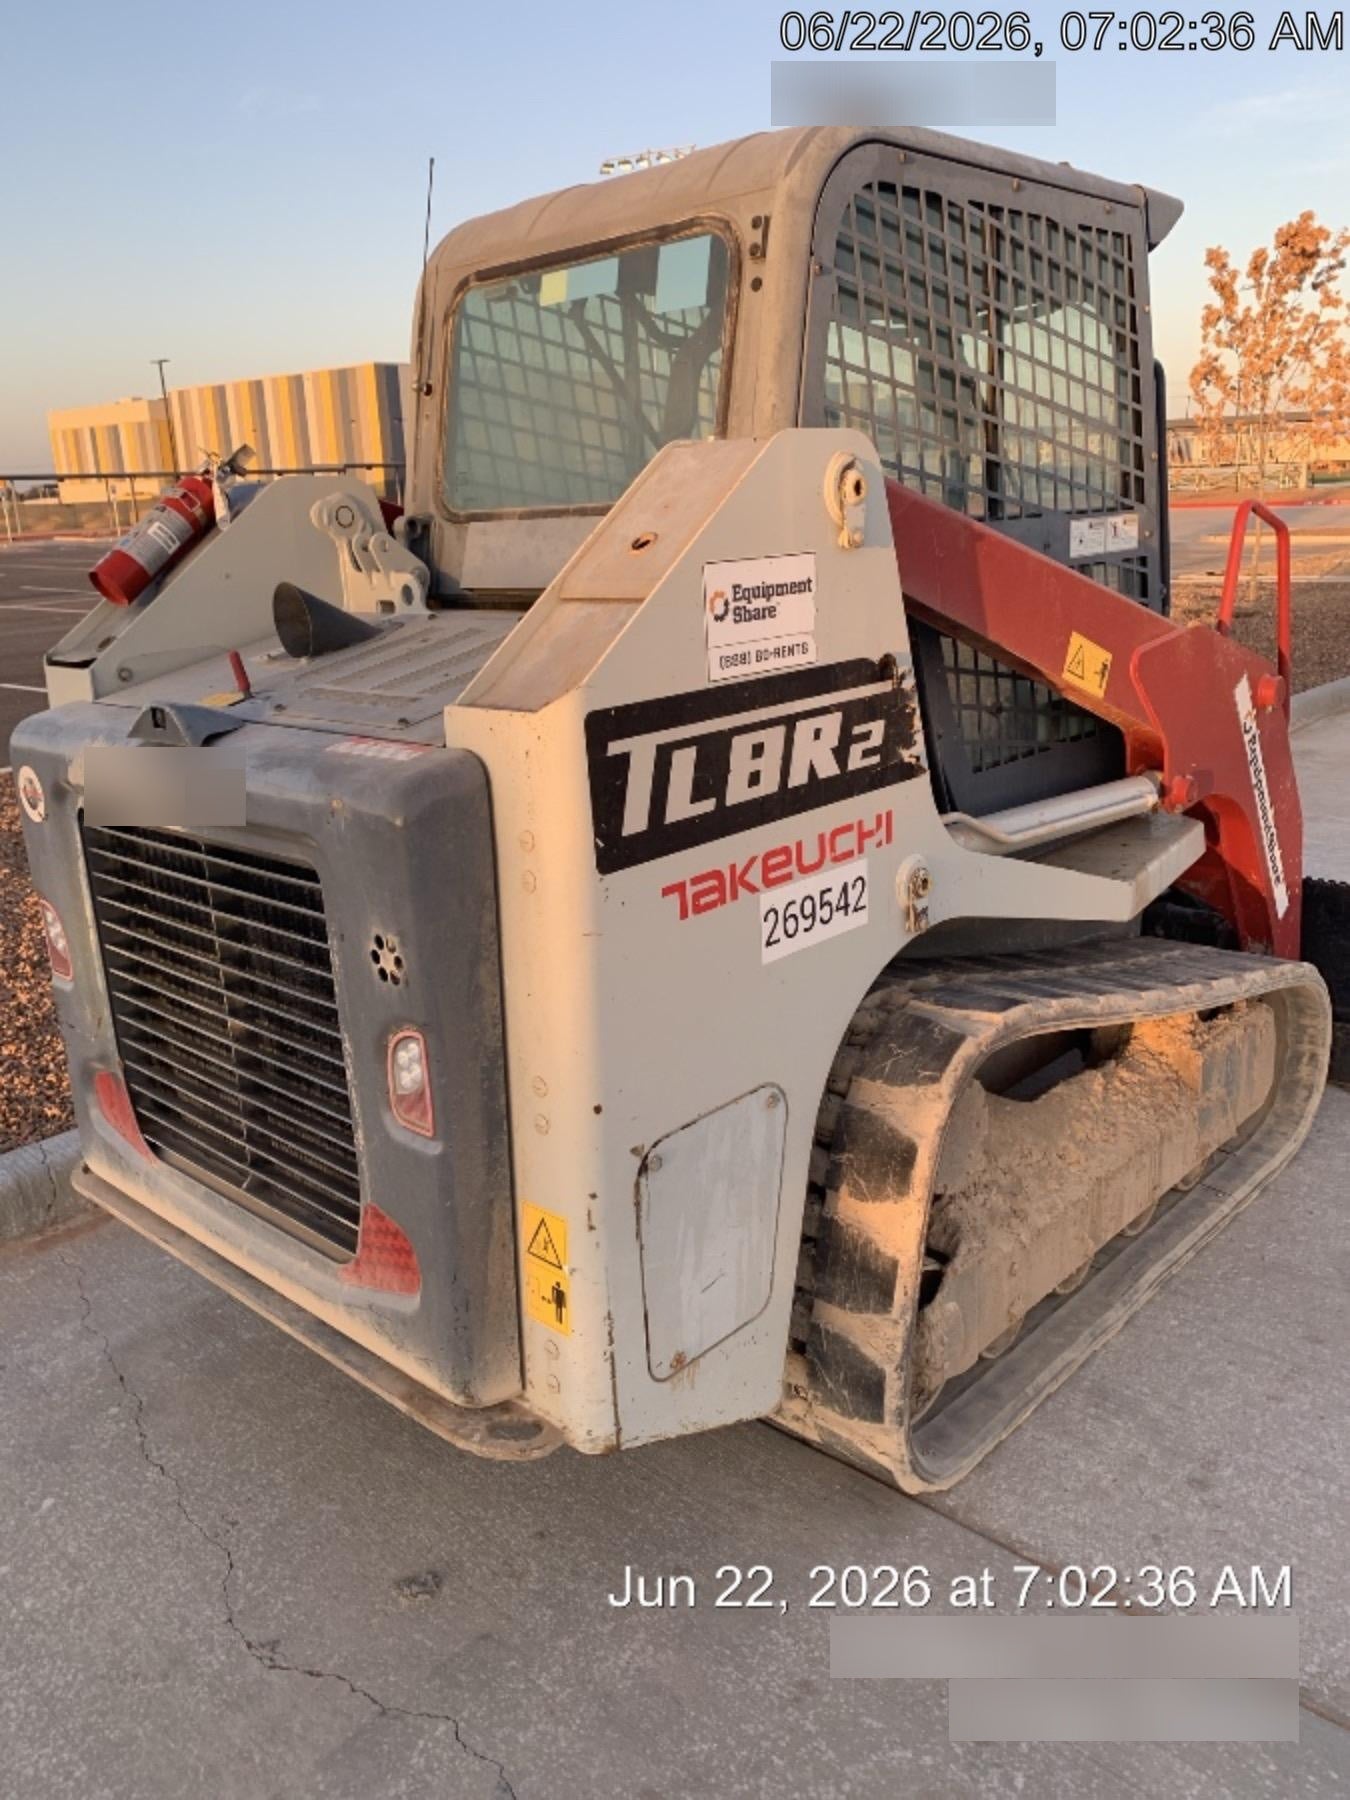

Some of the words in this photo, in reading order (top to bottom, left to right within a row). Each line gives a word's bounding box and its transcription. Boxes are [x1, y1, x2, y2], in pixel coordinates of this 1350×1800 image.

[731, 577, 813, 605] Equipment
[732, 605, 777, 624] Share
[763, 875, 868, 949] 269542
